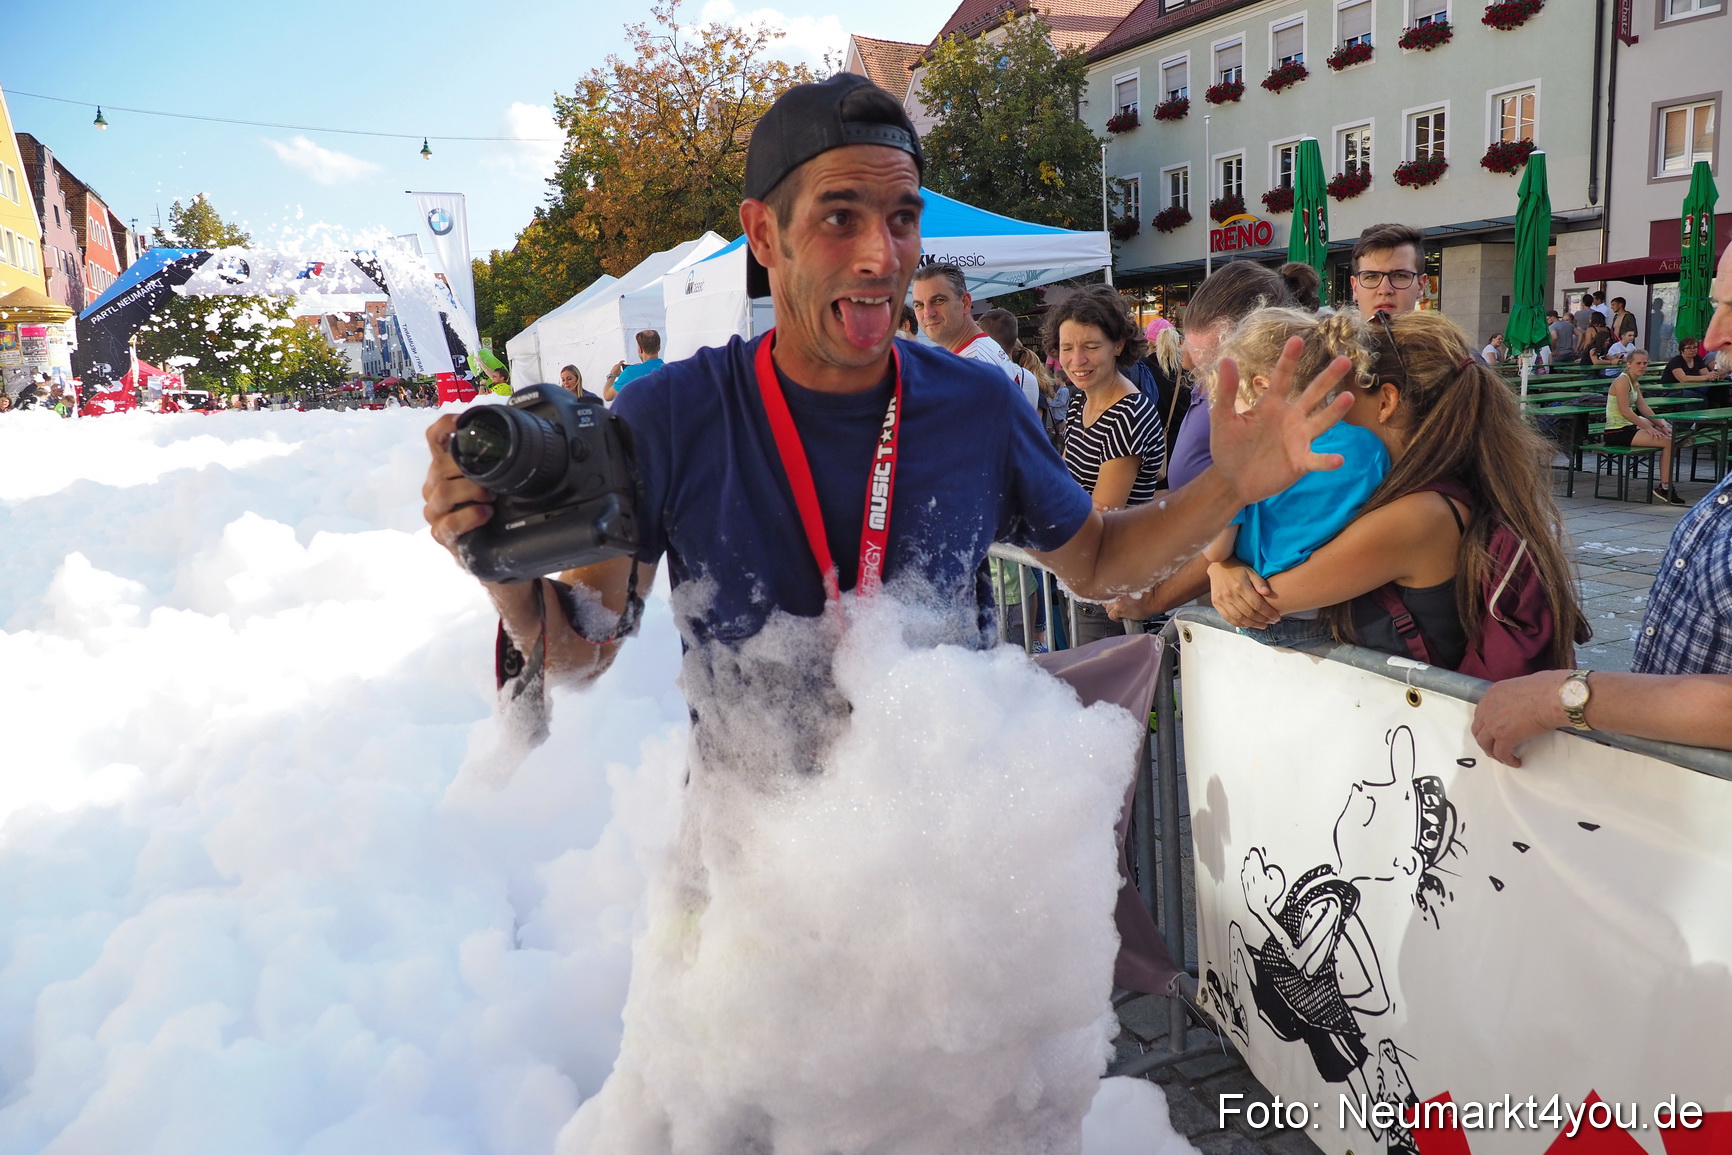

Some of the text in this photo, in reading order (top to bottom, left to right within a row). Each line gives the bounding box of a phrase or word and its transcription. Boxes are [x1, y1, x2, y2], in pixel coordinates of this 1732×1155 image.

[1210, 220, 1275, 253] RENO
[938, 252, 986, 267] classic
[90, 277, 165, 325] PARTL NEUMARKT
[508, 391, 540, 406] Canon
